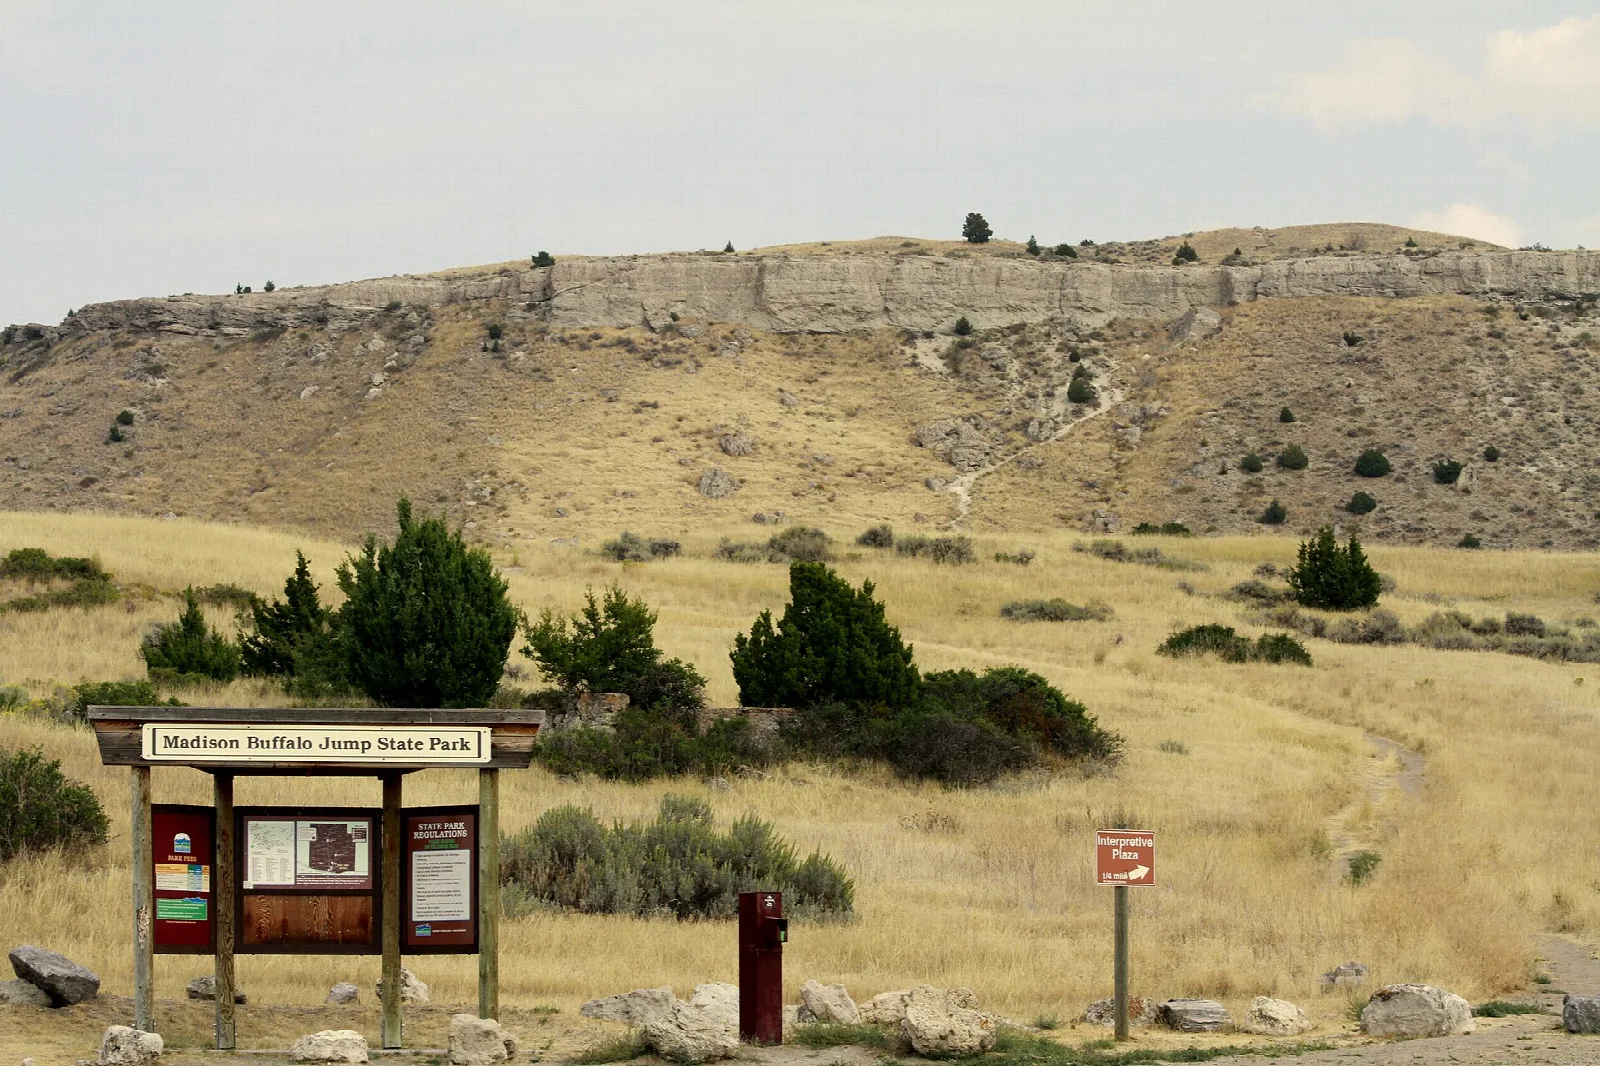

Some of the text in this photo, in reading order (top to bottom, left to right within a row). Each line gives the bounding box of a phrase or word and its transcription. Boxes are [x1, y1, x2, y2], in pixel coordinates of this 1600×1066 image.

[163, 735, 471, 754] Madison Buffalo Jump State Park
[418, 822, 465, 831] STATE PARK
[413, 829, 468, 839] REGULATIONS
[1097, 835, 1153, 849] Interpretive
[1112, 848, 1139, 860] Plaza
[1102, 871, 1128, 880] 1/4 mile
